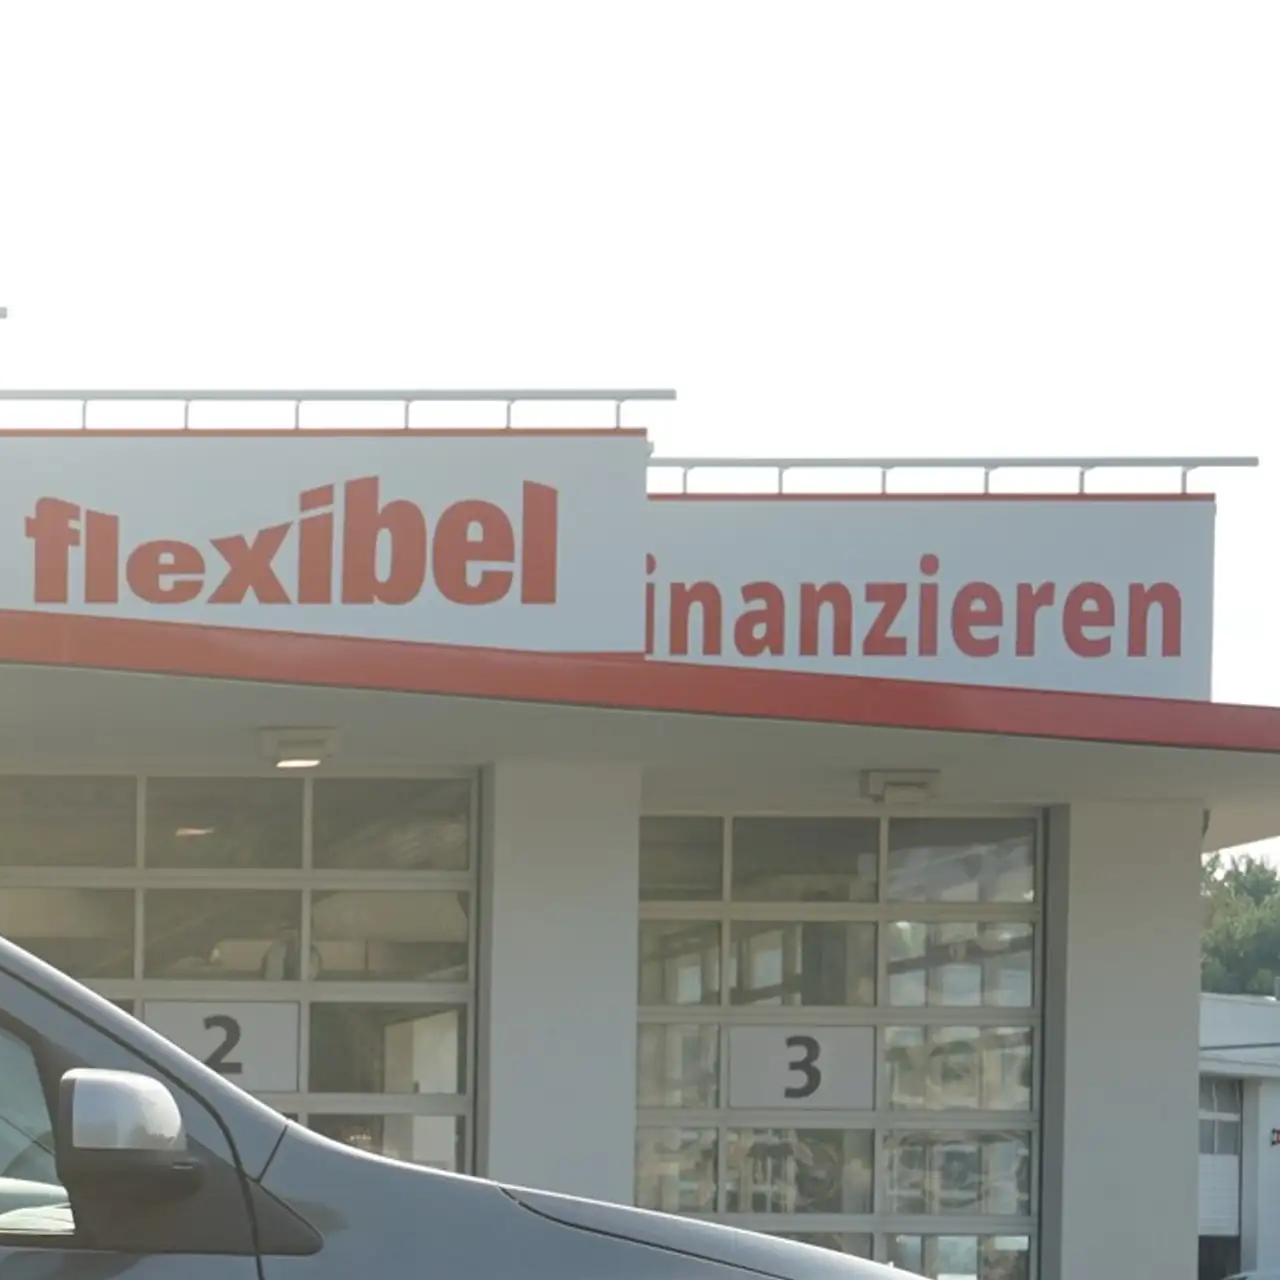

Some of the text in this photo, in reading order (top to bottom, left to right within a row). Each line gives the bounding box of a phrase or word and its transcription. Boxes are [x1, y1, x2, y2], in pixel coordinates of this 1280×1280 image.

[25, 476, 557, 605] flexibel
[202, 1014, 243, 1074] 2
[783, 1036, 822, 1099] 3
